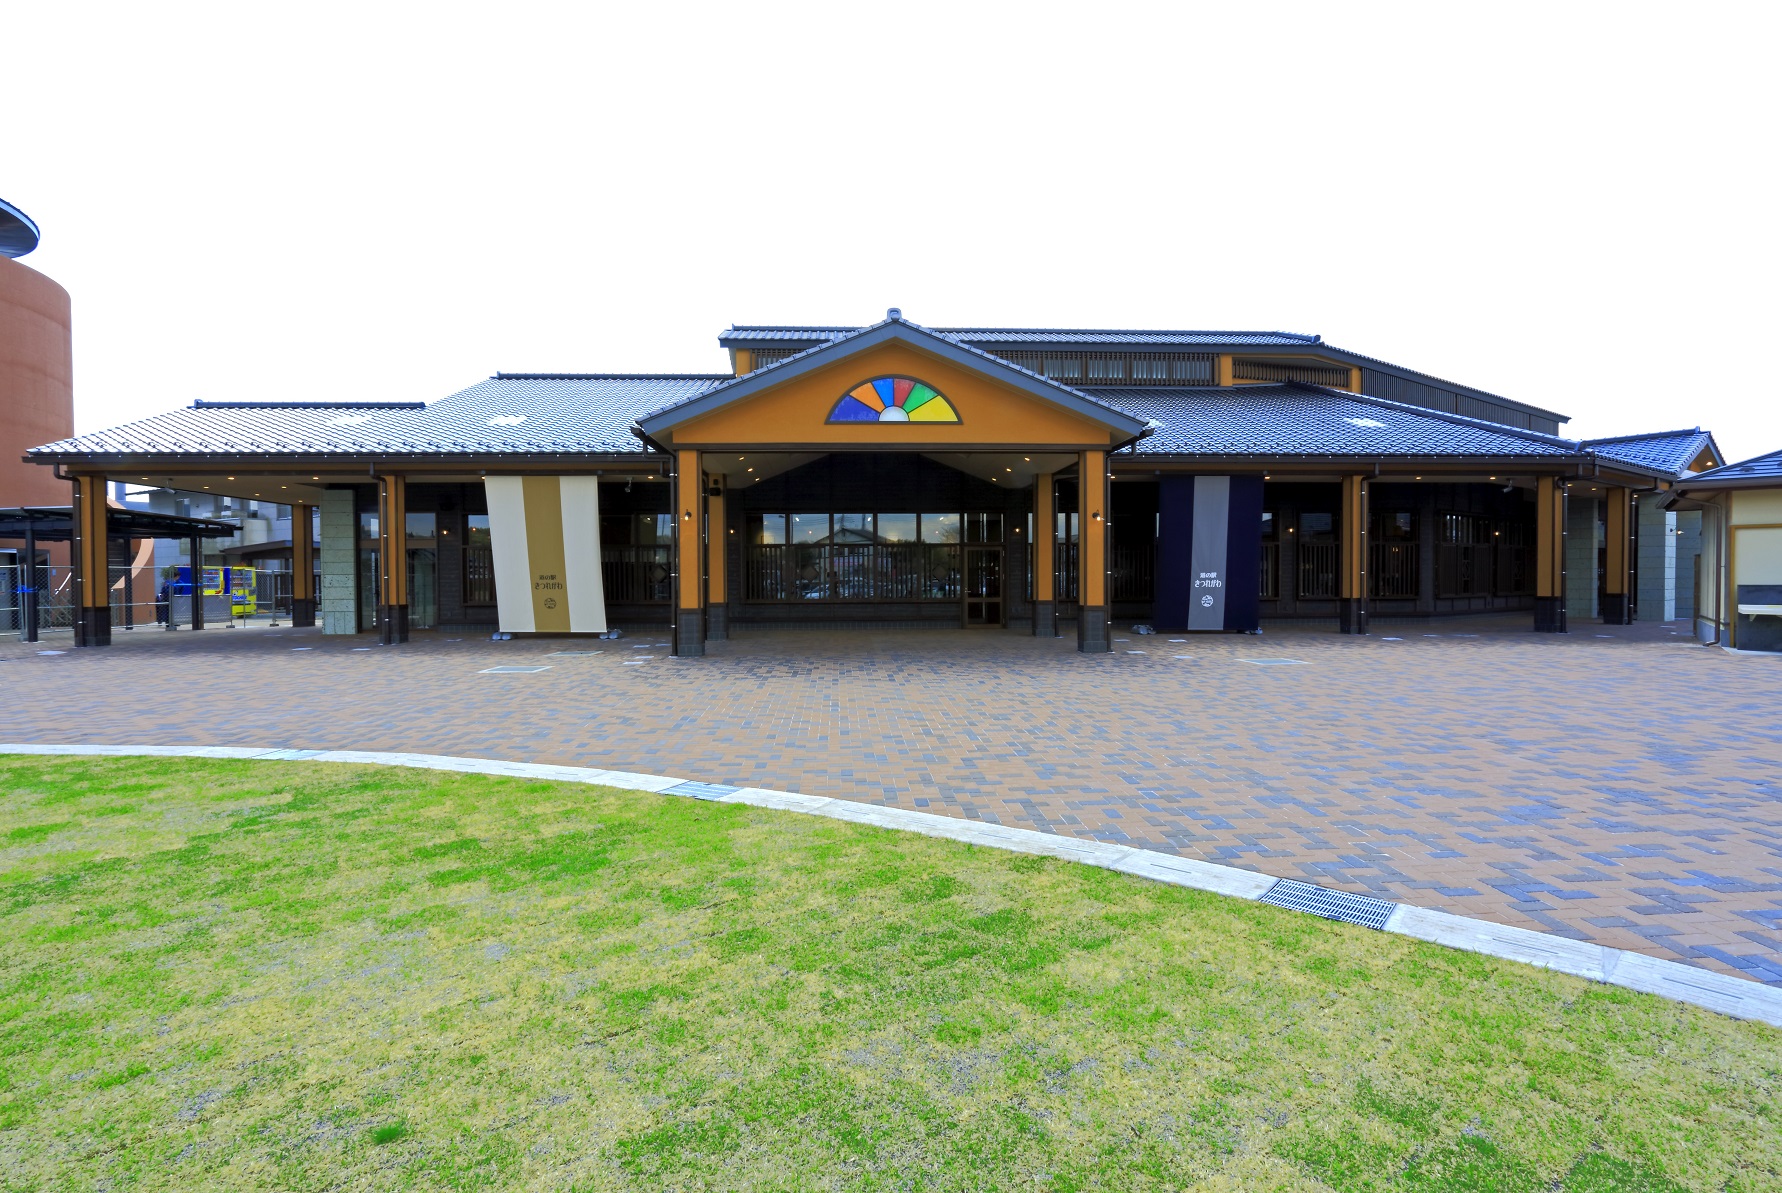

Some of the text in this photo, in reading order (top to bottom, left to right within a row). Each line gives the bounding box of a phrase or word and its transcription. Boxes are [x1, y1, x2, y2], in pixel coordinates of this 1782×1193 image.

[535, 582, 563, 590] きつれがわ
[1194, 580, 1222, 588] きつれがわ
